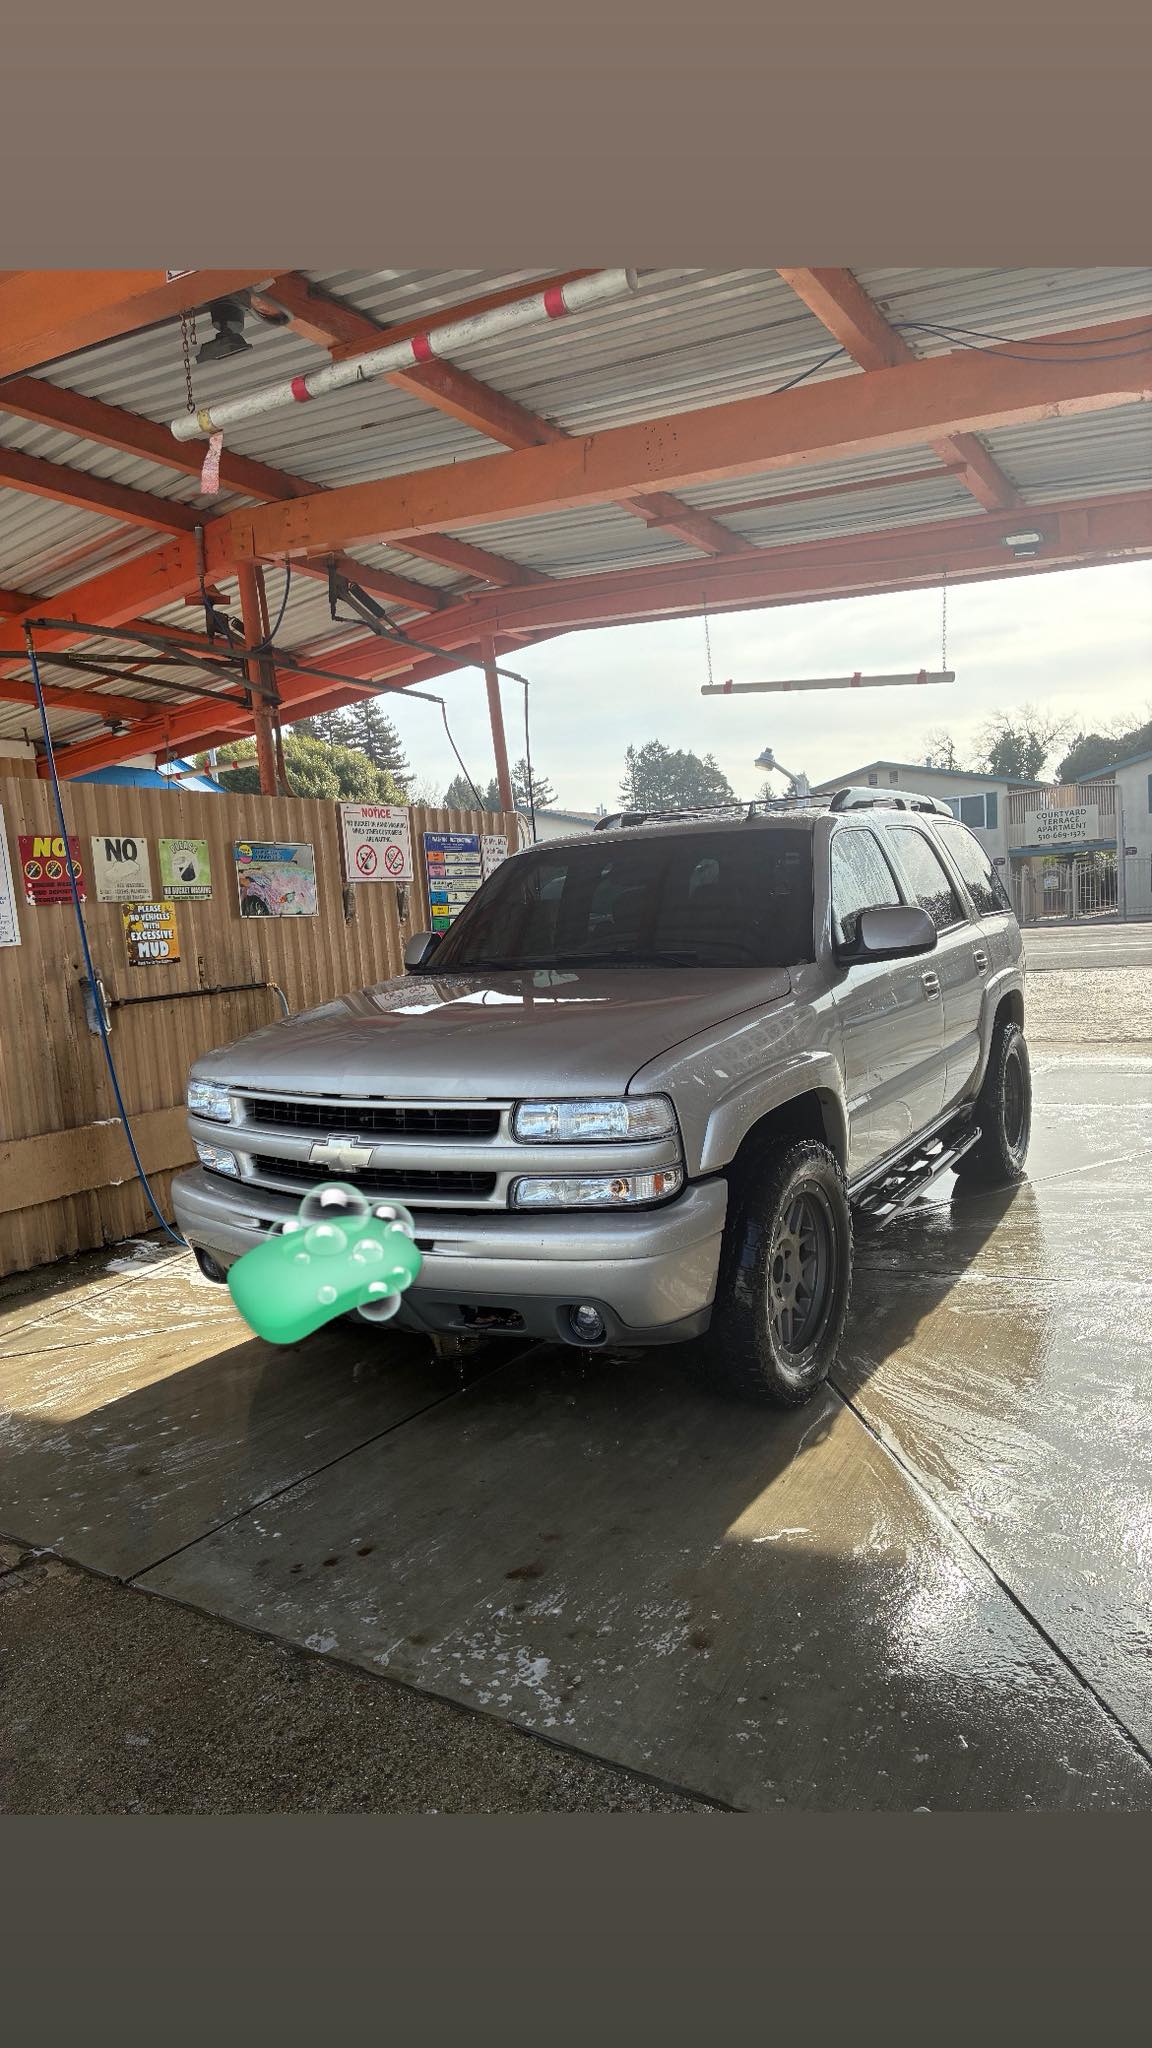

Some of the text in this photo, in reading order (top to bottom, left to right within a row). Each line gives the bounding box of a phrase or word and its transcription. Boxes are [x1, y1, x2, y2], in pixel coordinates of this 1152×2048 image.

[361, 807, 392, 819] NOTICE
[1036, 808, 1087, 820] COURTYARD
[1043, 815, 1080, 826] TERRACE
[1036, 822, 1087, 833] APARTMENT
[32, 837, 67, 858] NO
[104, 838, 138, 862] NO
[170, 840, 198, 855] PLEASE
[137, 904, 161, 913] PLEASE
[141, 911, 170, 921] VEHICLES
[131, 929, 174, 941] EXCESSIVE
[137, 940, 170, 958] MUD
